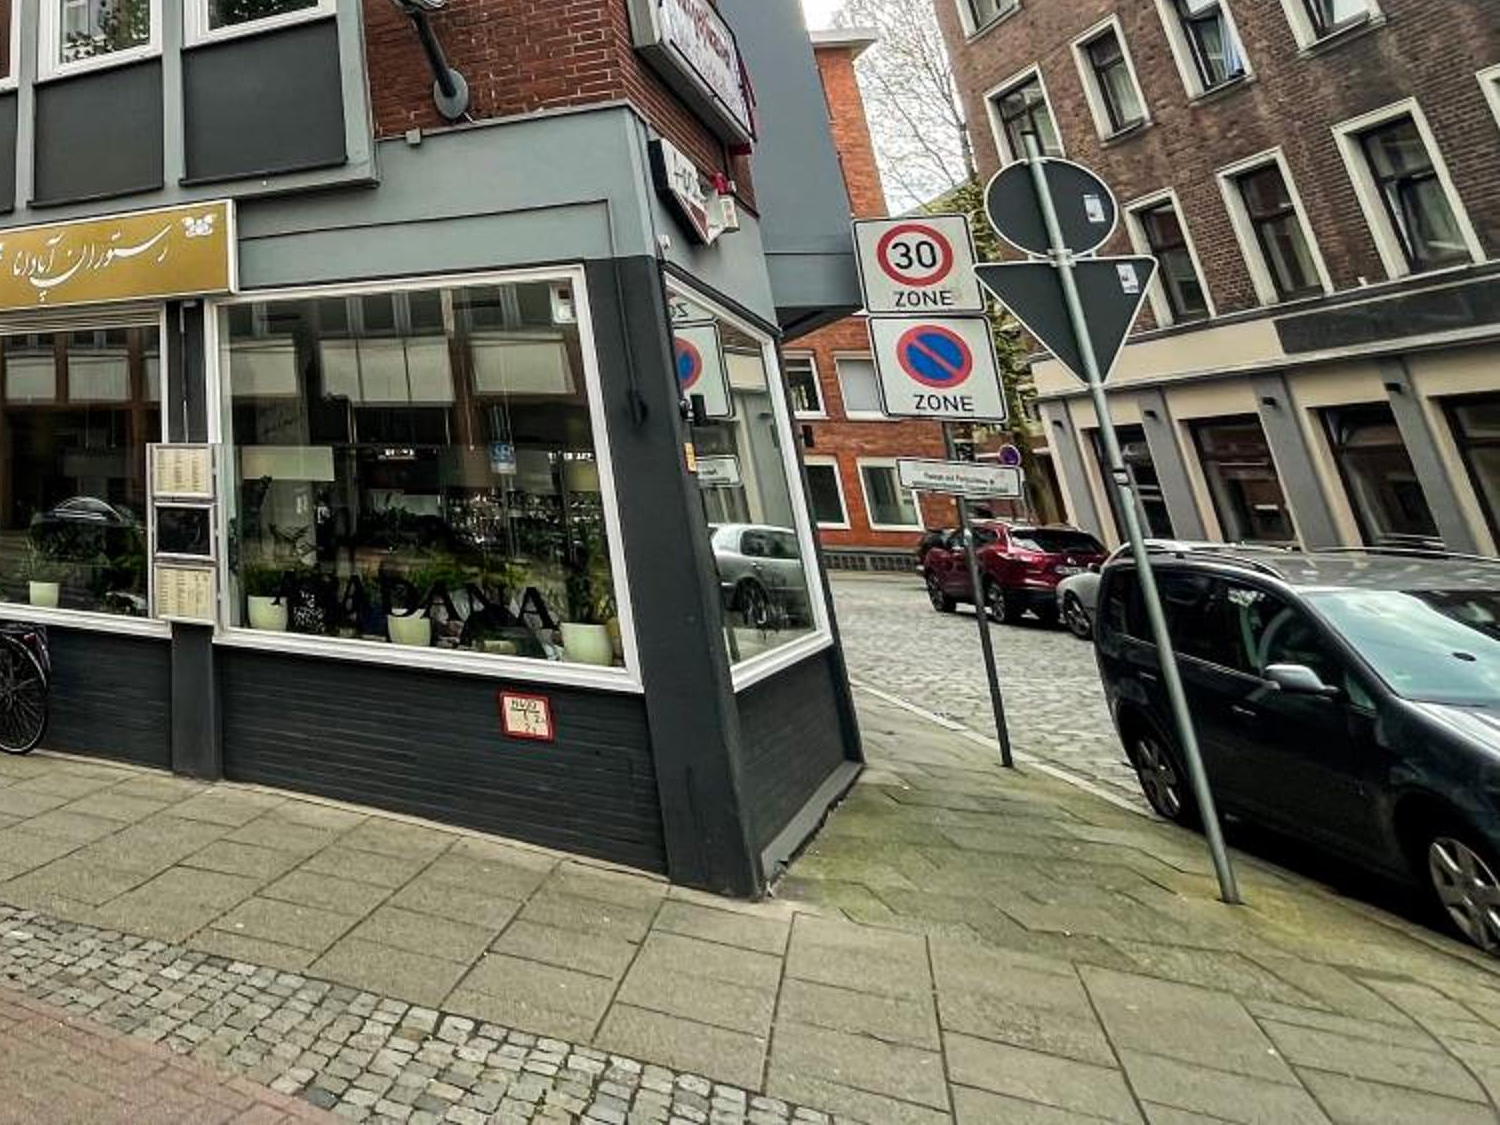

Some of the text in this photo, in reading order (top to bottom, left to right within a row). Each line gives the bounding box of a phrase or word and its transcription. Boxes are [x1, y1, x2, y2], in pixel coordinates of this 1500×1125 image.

[892, 241, 937, 269] 30
[894, 290, 954, 307] ZONE
[913, 394, 975, 412] ZONE
